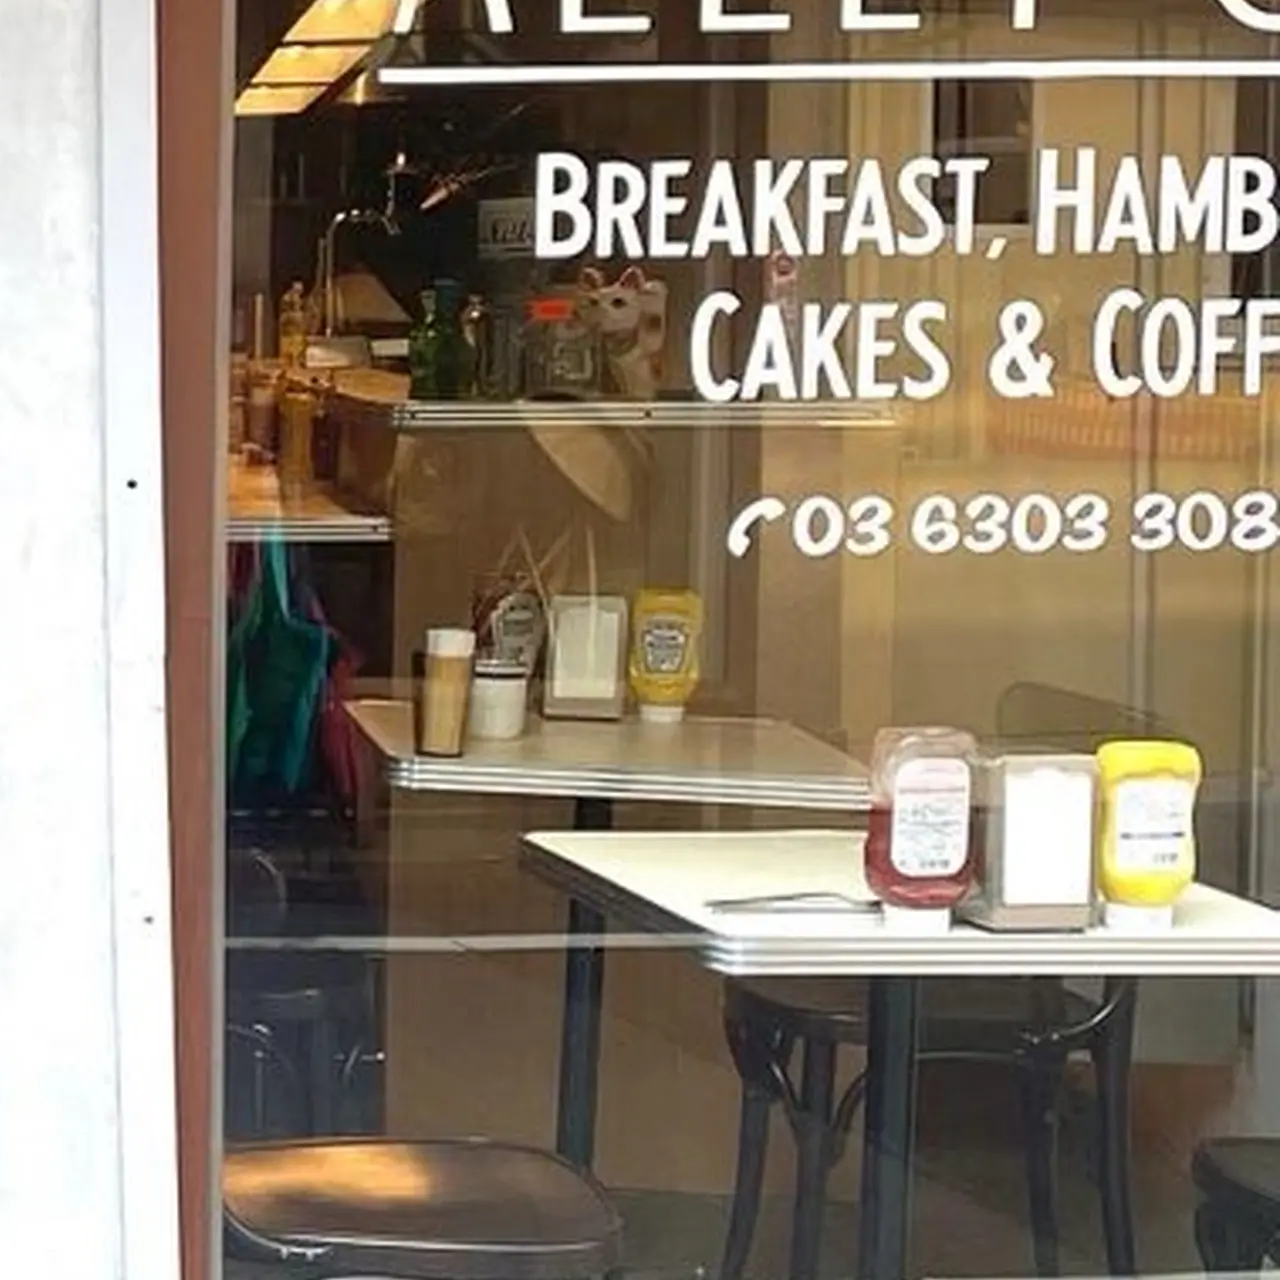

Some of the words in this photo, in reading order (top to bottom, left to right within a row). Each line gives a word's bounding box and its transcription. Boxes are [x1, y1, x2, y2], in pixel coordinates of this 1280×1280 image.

[534, 151, 1008, 261] BREAKFAST,
[1036, 147, 1278, 254] HAMB
[690, 290, 950, 402] CAKES
[988, 300, 1055, 398] &
[1093, 288, 1280, 398] COFF
[792, 496, 894, 557] 03
[911, 493, 1109, 554] 6303
[1130, 491, 1279, 551] 308
